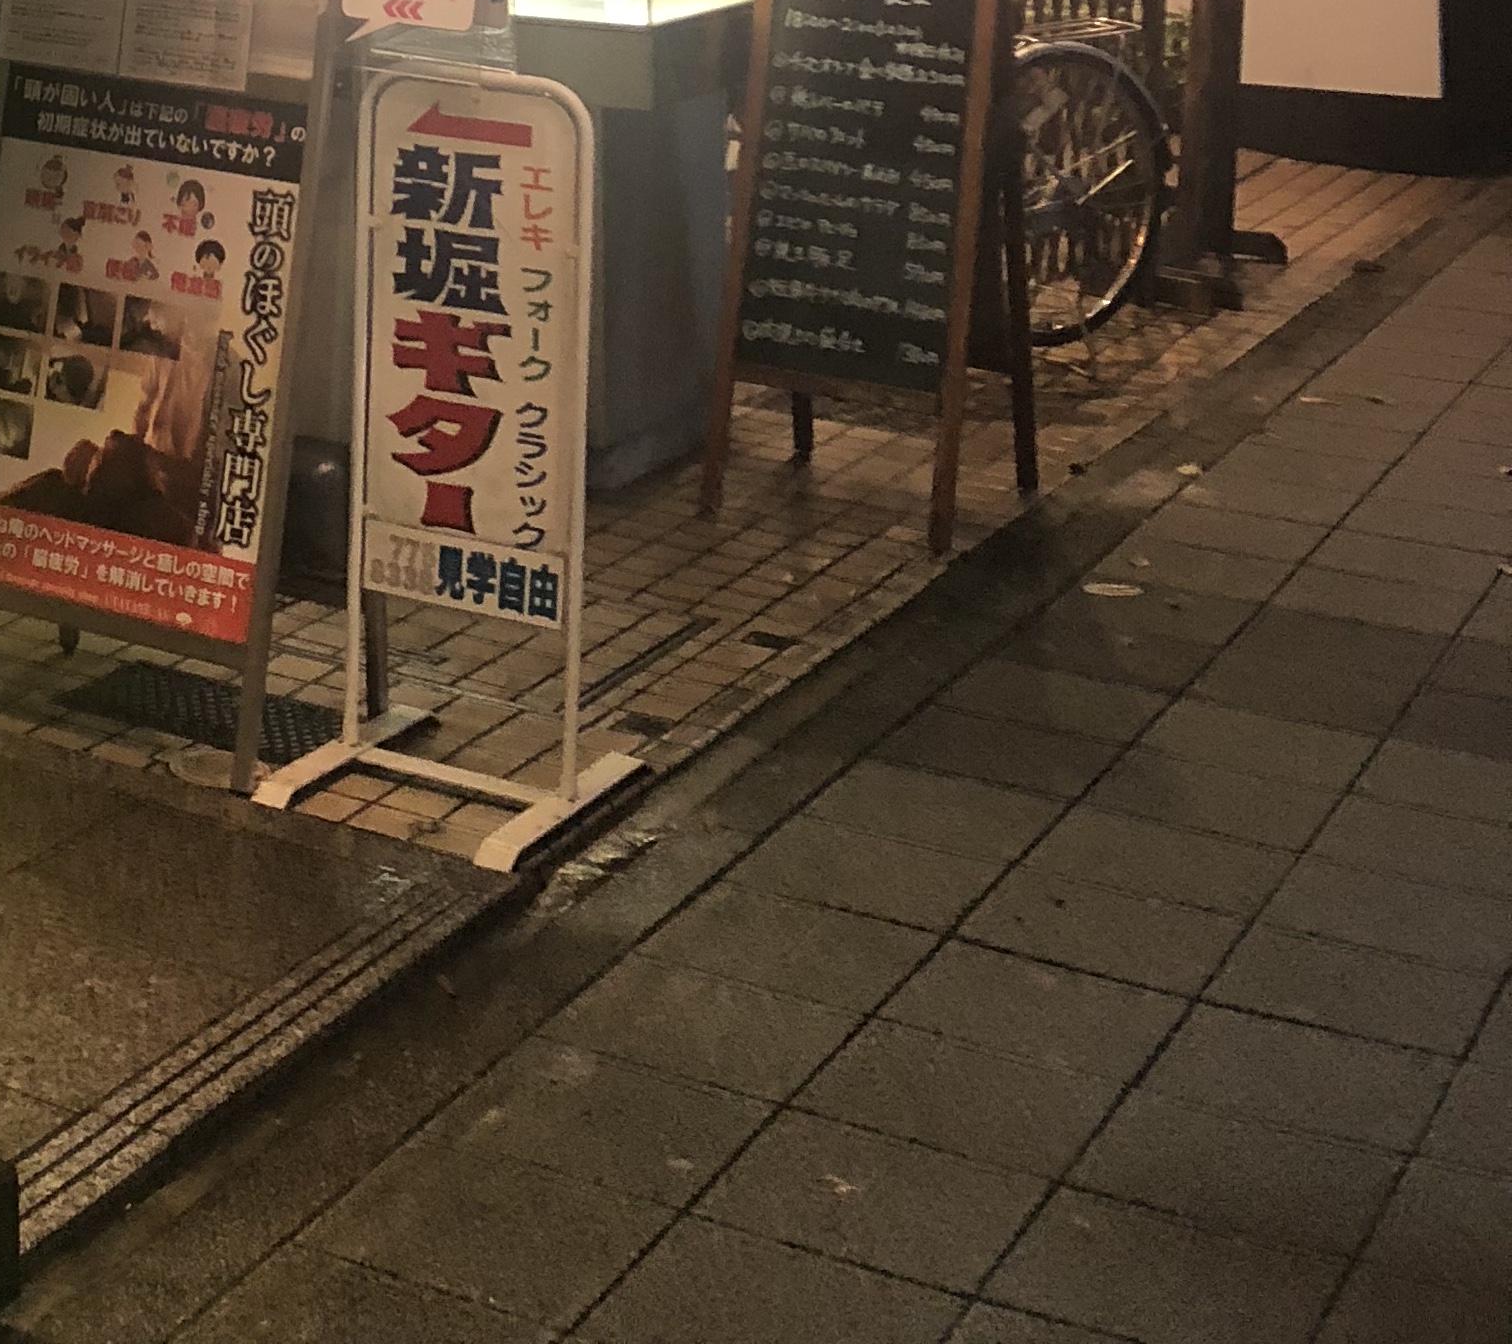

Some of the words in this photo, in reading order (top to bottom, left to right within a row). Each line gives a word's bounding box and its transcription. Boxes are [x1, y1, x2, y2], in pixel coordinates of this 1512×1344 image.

[520, 165, 554, 252] エレキ
[215, 187, 296, 548] 頭のほぐし専門店
[387, 143, 512, 535] 新堀ギター
[519, 266, 553, 383] フォーク
[512, 400, 549, 550] クラシック
[435, 544, 559, 621] 見学自由
